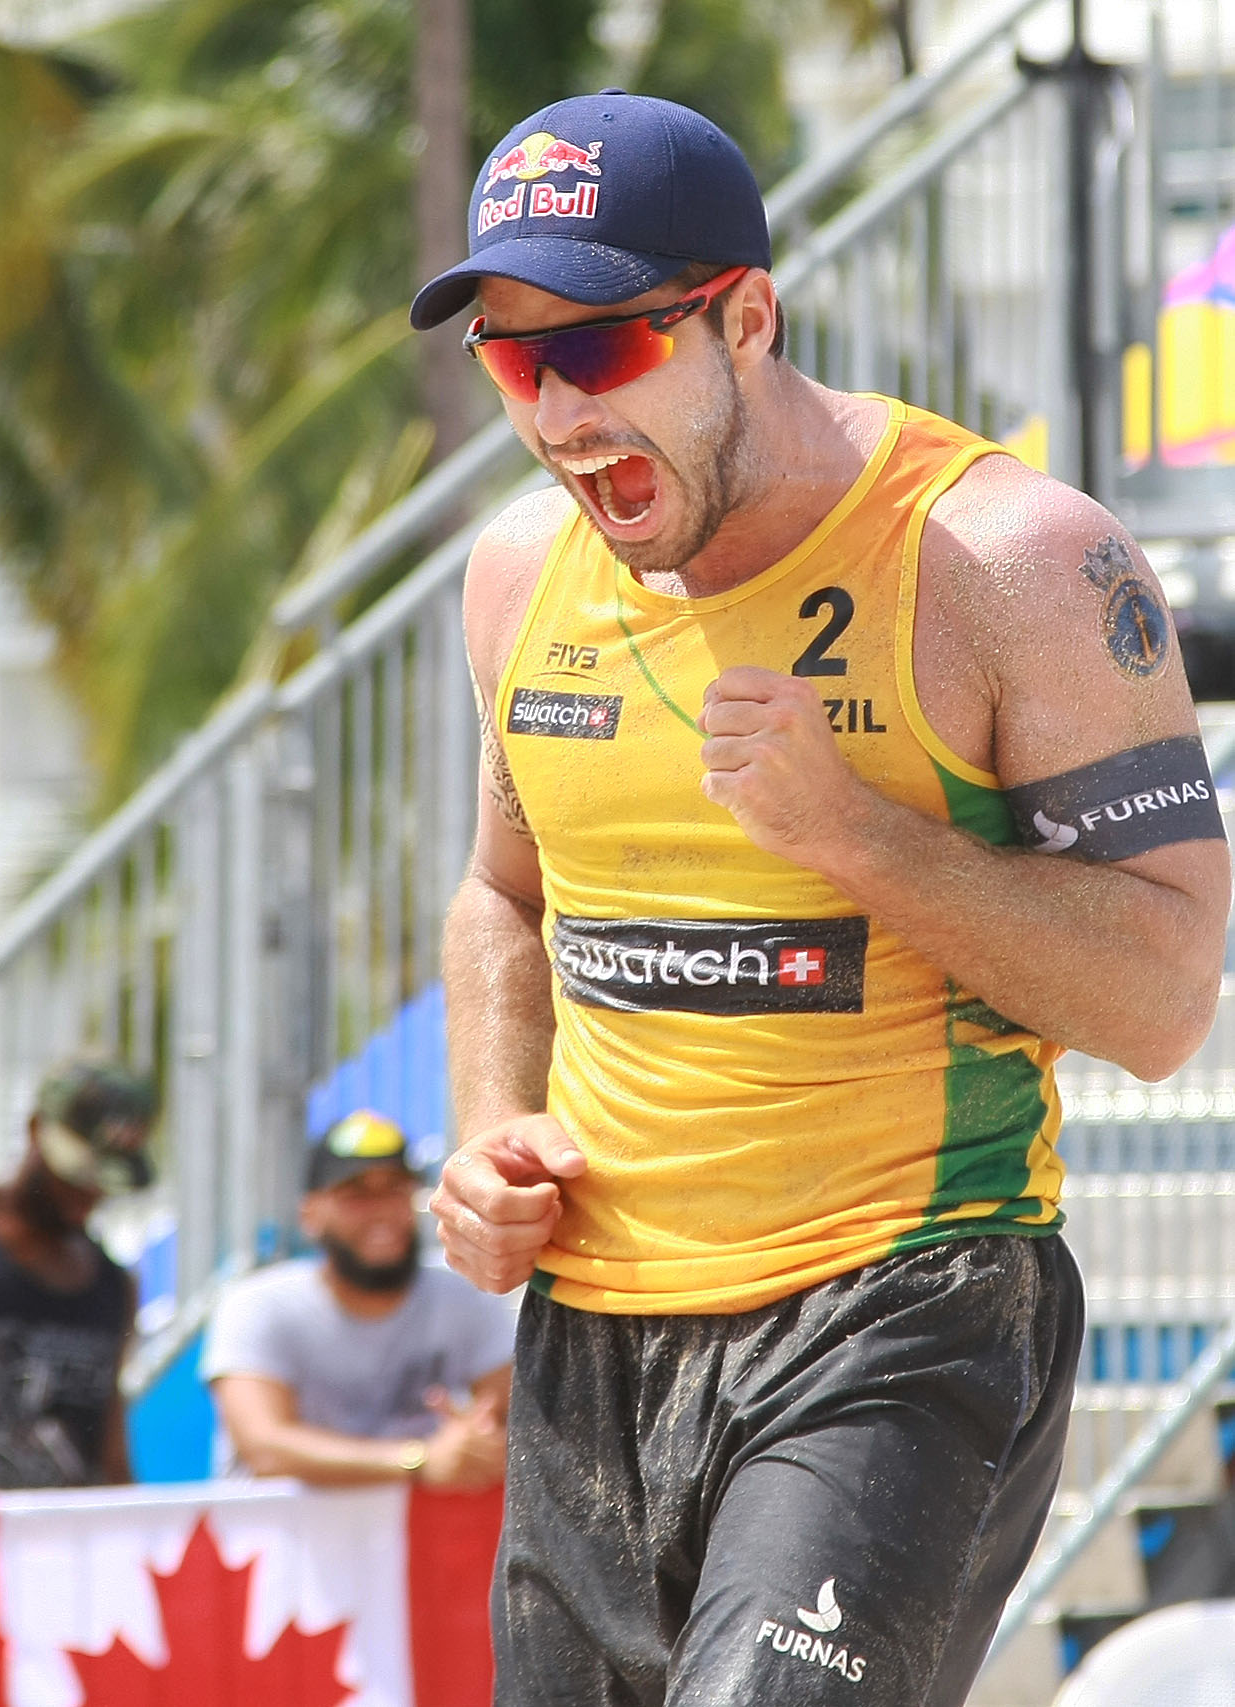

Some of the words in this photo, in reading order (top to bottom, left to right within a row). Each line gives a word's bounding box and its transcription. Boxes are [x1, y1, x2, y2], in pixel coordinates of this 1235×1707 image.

[477, 183, 526, 235] Red
[529, 182, 599, 218] Bull
[792, 586, 855, 677] 2
[512, 701, 590, 726] swatch
[822, 699, 887, 733] ZIL
[1080, 780, 1210, 831] FURNAS
[559, 941, 769, 986] swatch
[756, 1620, 867, 1683] FURNAS
